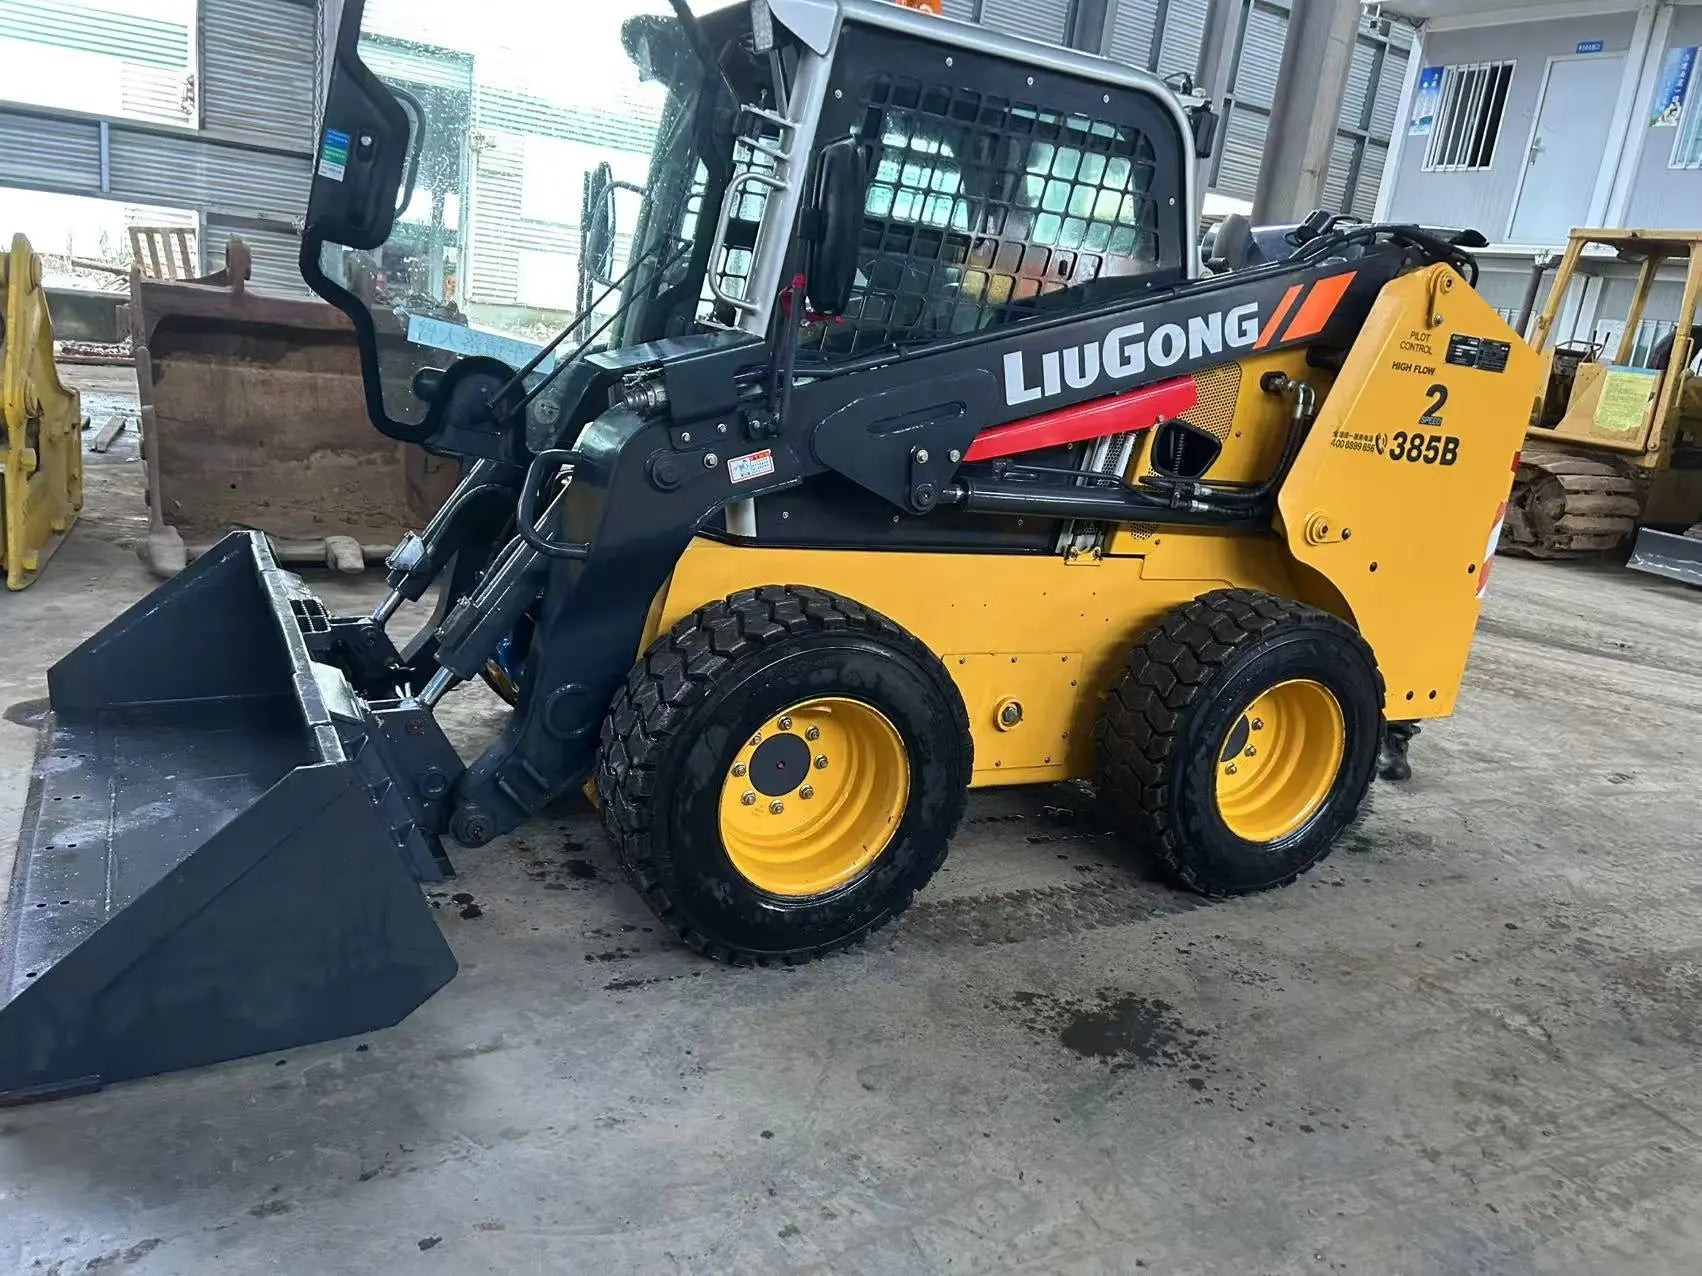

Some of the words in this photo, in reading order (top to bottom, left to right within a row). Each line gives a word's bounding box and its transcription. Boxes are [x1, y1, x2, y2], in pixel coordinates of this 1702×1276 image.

[1410, 331, 1431, 341] PILOT
[1003, 301, 1258, 405] LIUGONG
[1400, 341, 1432, 354] CONTROL
[1392, 361, 1412, 372] HIGH
[1413, 364, 1435, 375] FLOW
[1418, 384, 1448, 426] 2
[1420, 416, 1442, 425] SPEED
[1331, 438, 1345, 448] 400
[1389, 430, 1459, 466] 385B
